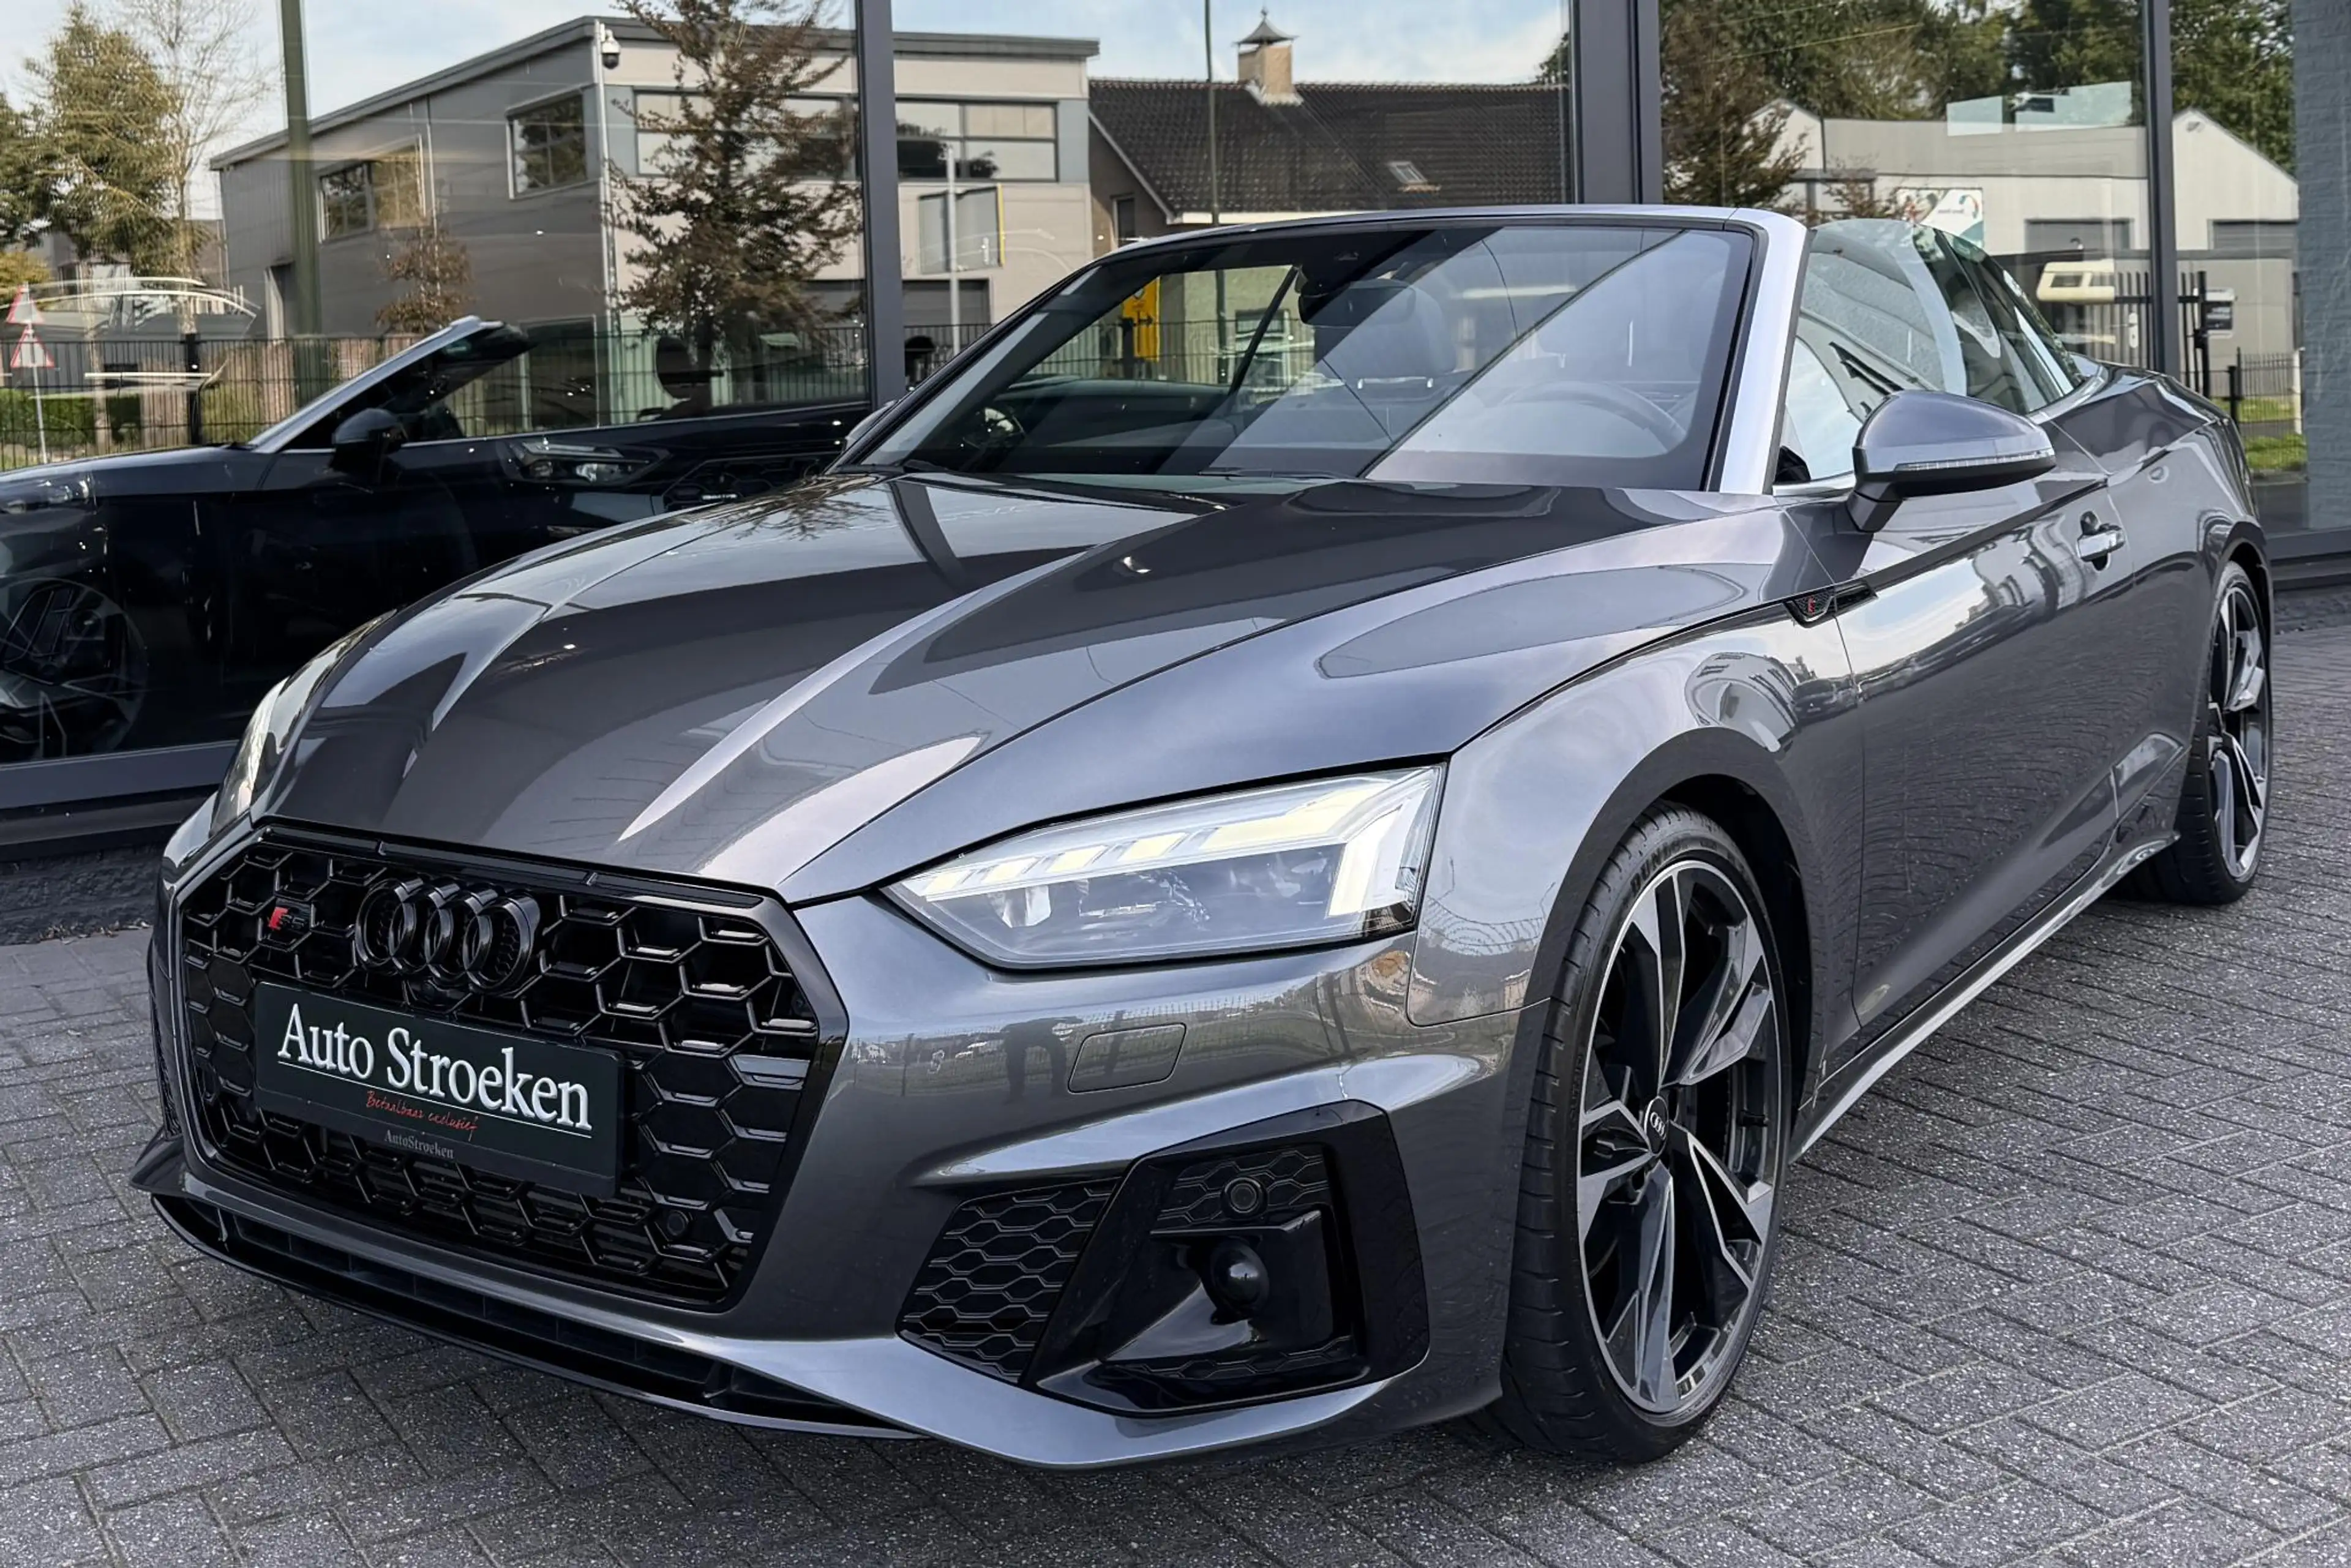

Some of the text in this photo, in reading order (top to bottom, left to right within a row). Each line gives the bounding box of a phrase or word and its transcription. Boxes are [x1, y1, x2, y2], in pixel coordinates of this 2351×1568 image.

[277, 1002, 592, 1131] Auto Stroeken
[384, 1129, 454, 1159] AutoStroeken
